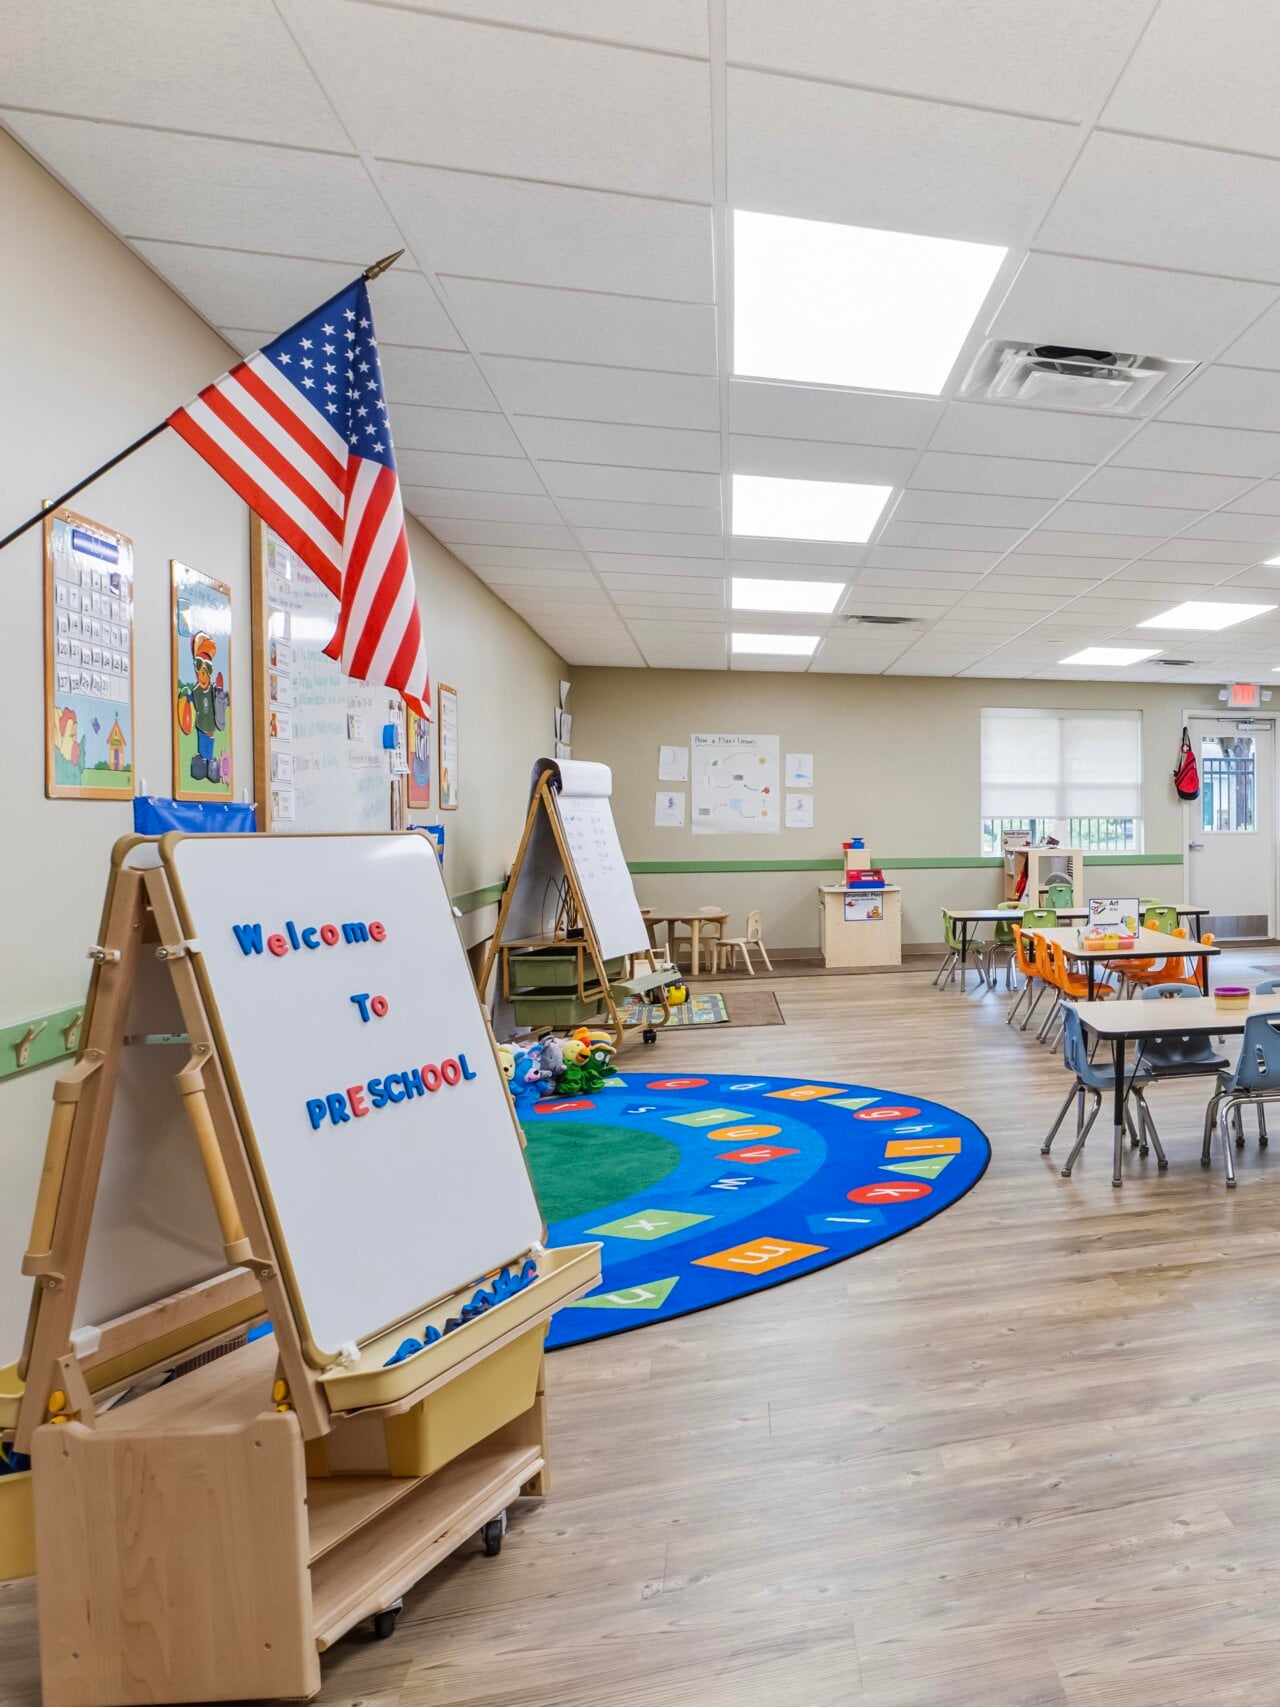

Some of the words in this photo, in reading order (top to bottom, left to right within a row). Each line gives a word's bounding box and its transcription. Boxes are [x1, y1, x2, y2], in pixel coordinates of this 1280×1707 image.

[694, 735, 708, 744] How
[718, 736, 736, 744] Plant
[232, 921, 387, 957] Welcome
[350, 993, 389, 1023] To
[306, 1053, 477, 1130] PRESCHOOL
[893, 1124, 933, 1134] h
[866, 1187, 920, 1197] k
[622, 1219, 671, 1231] x
[728, 1245, 793, 1264] m
